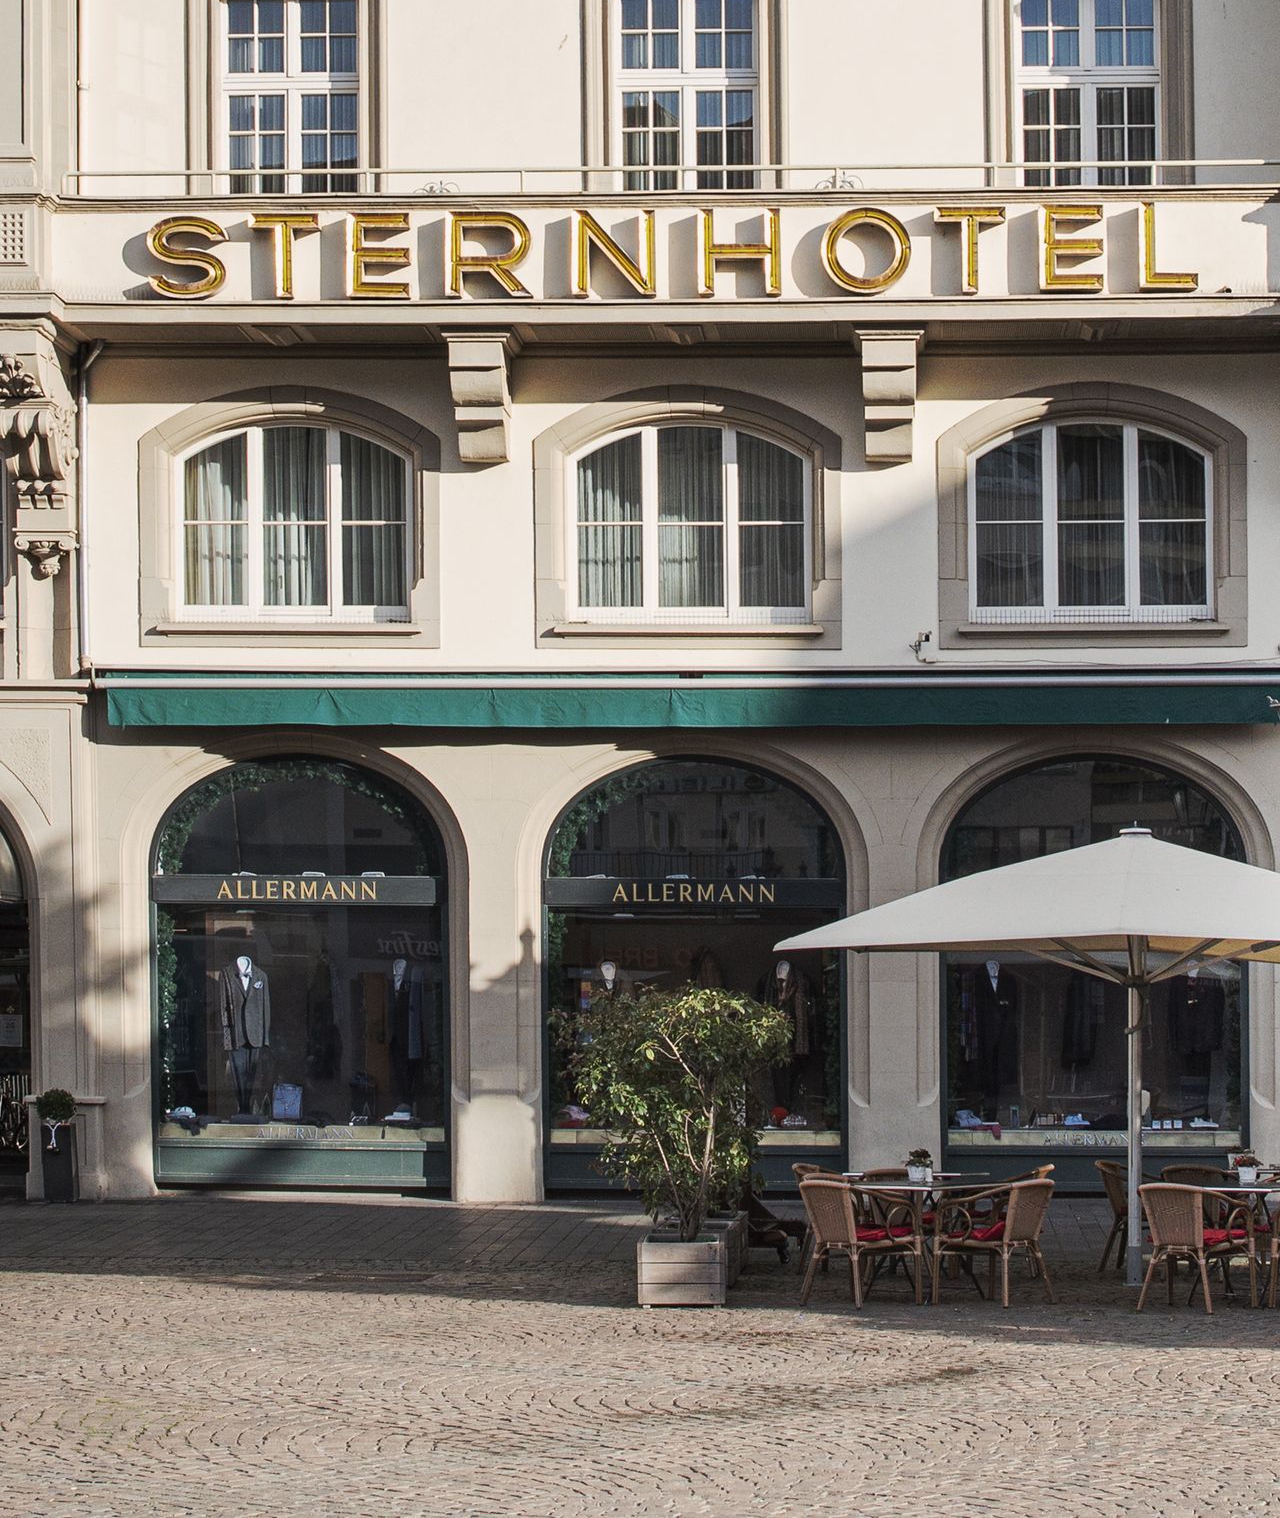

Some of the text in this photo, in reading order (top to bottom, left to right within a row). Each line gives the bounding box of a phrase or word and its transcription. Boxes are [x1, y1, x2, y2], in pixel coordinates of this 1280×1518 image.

[145, 201, 1199, 301] STERNHOTEL
[216, 879, 377, 901] ALLERMANN
[612, 882, 775, 903] ALLERMANN
[256, 1127, 354, 1139] ALLERMANN
[1043, 1133, 1143, 1146] ALLERMAN
